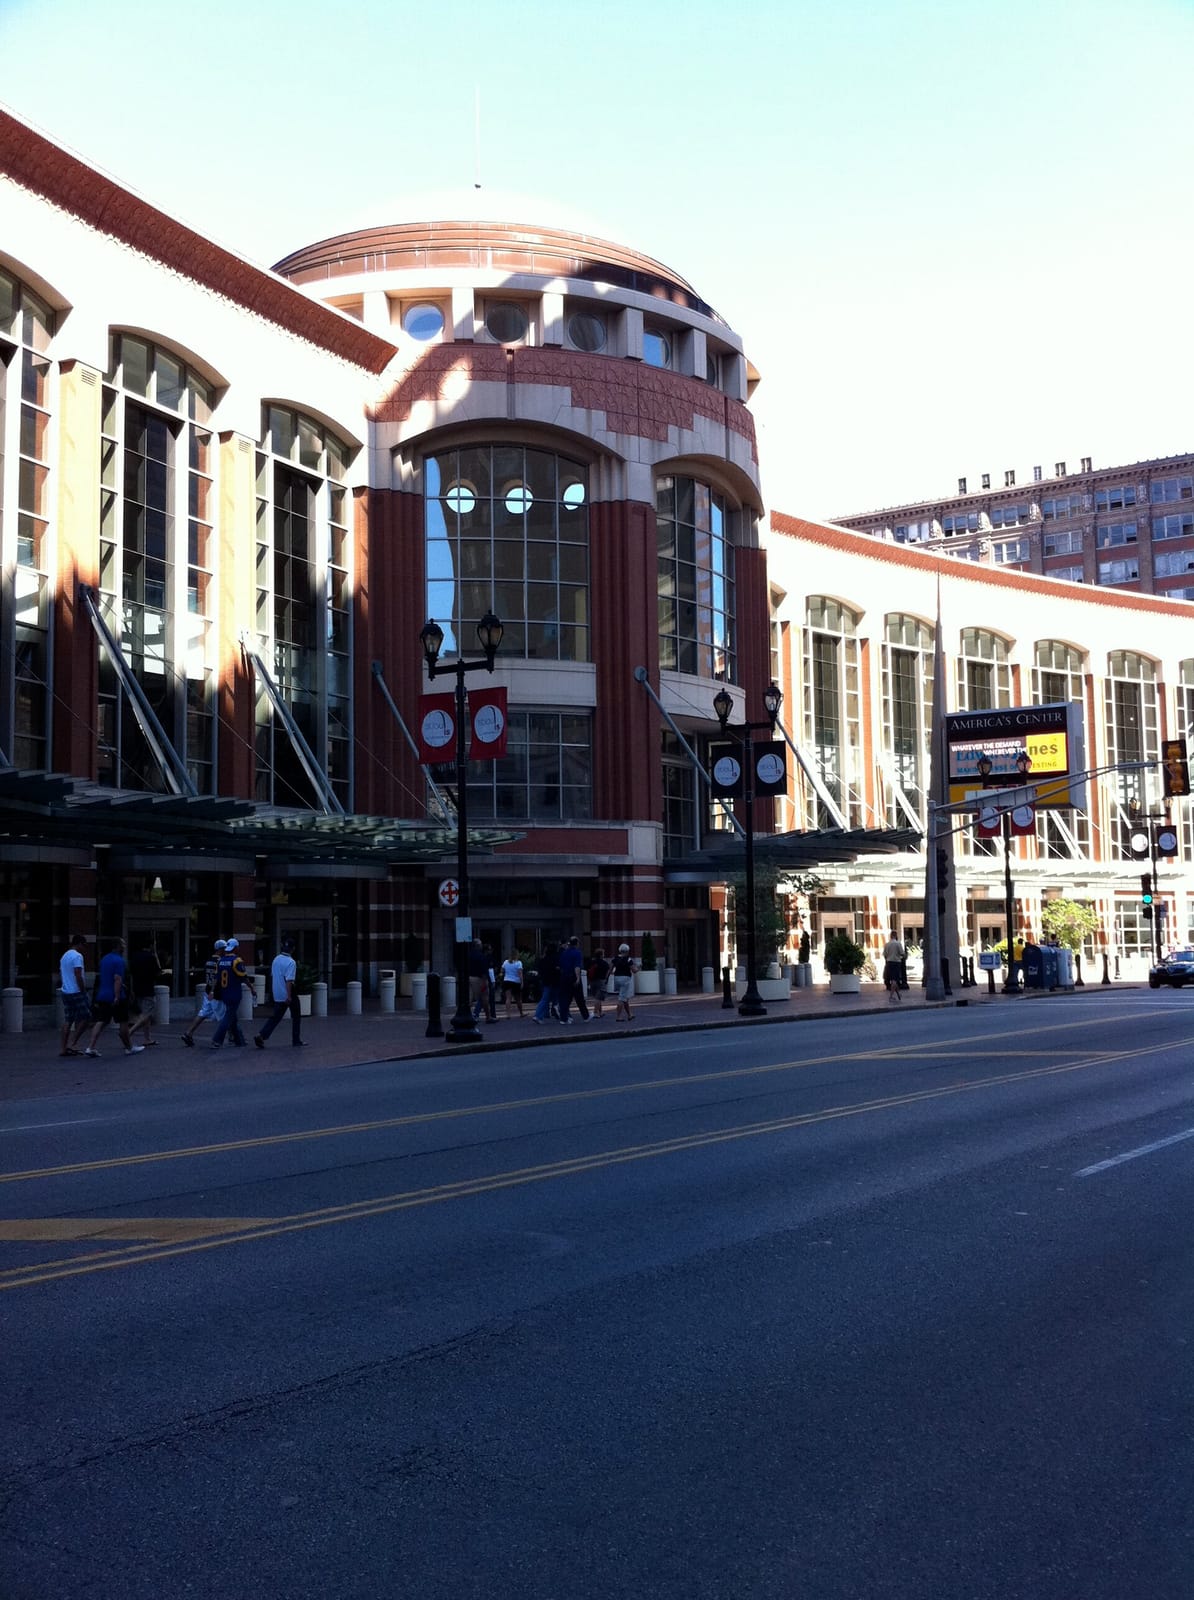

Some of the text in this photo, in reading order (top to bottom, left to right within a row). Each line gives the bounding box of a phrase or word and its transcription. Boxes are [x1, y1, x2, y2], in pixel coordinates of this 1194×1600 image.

[951, 712, 1062, 729] AMERICA'S CENTER
[221, 969, 229, 988] 8
